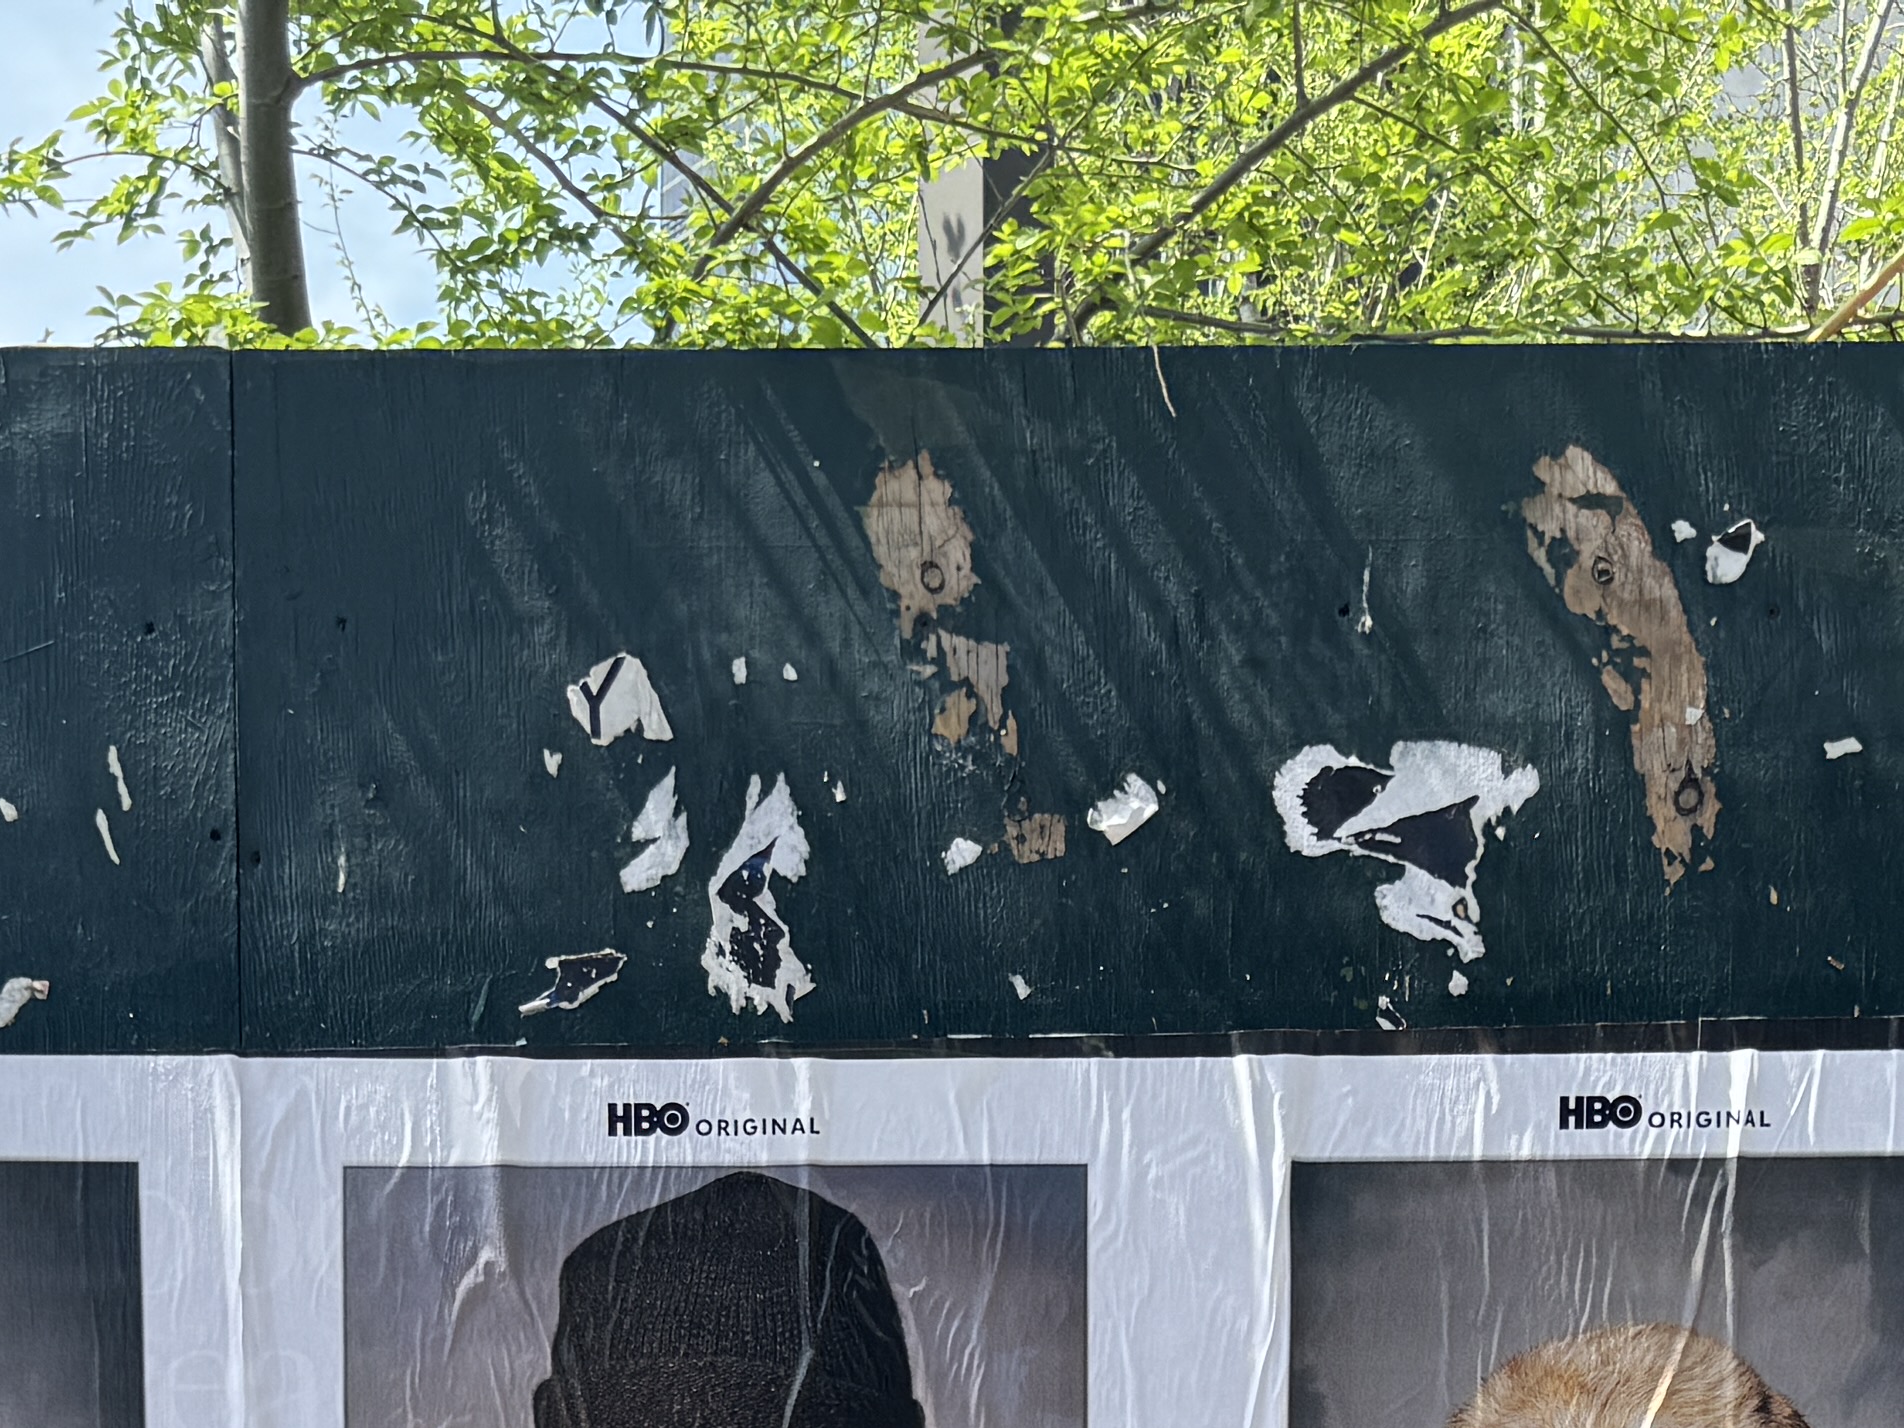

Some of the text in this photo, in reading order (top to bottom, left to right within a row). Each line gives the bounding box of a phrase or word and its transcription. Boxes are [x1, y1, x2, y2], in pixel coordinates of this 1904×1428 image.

[607, 1102, 820, 1137] HBO ORIGINAL
[1559, 1095, 1771, 1130] HBO ORIGINAL
